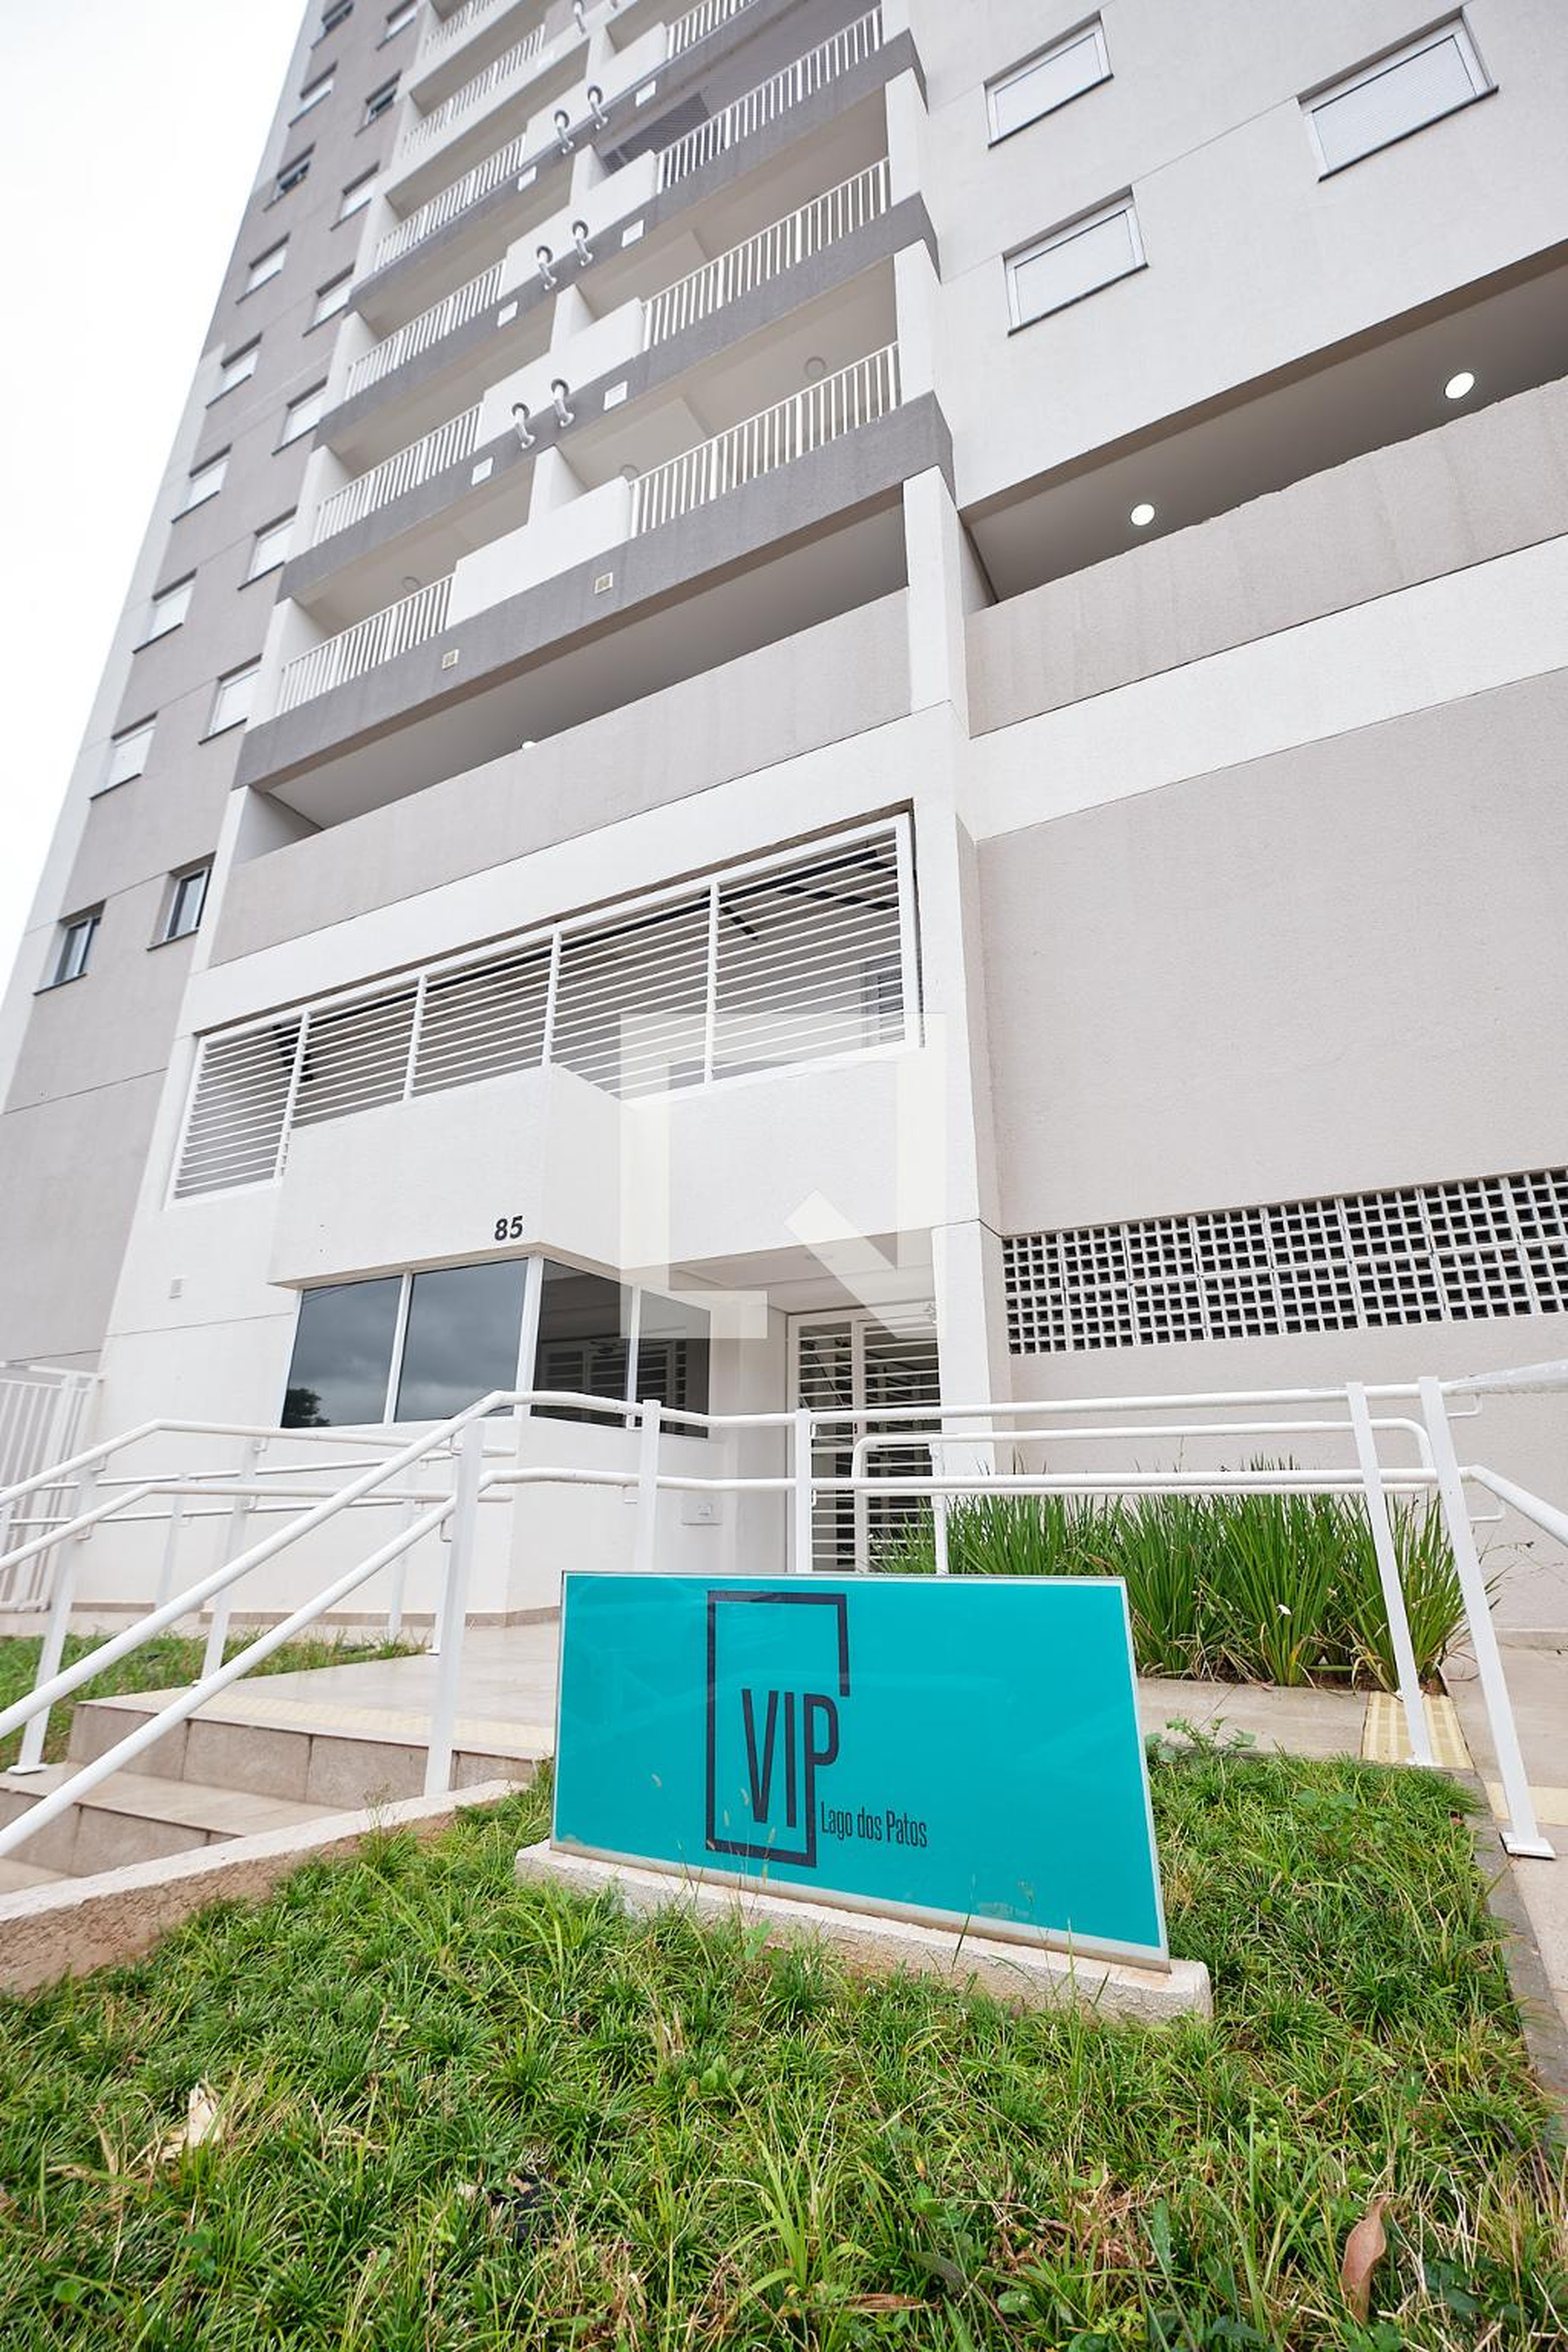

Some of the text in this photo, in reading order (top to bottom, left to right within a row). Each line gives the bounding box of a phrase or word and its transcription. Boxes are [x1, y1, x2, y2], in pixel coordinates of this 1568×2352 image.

[494, 1215, 523, 1241] 85
[741, 1688, 840, 1835] VIP
[820, 1800, 927, 1847] Lago dos Patos
